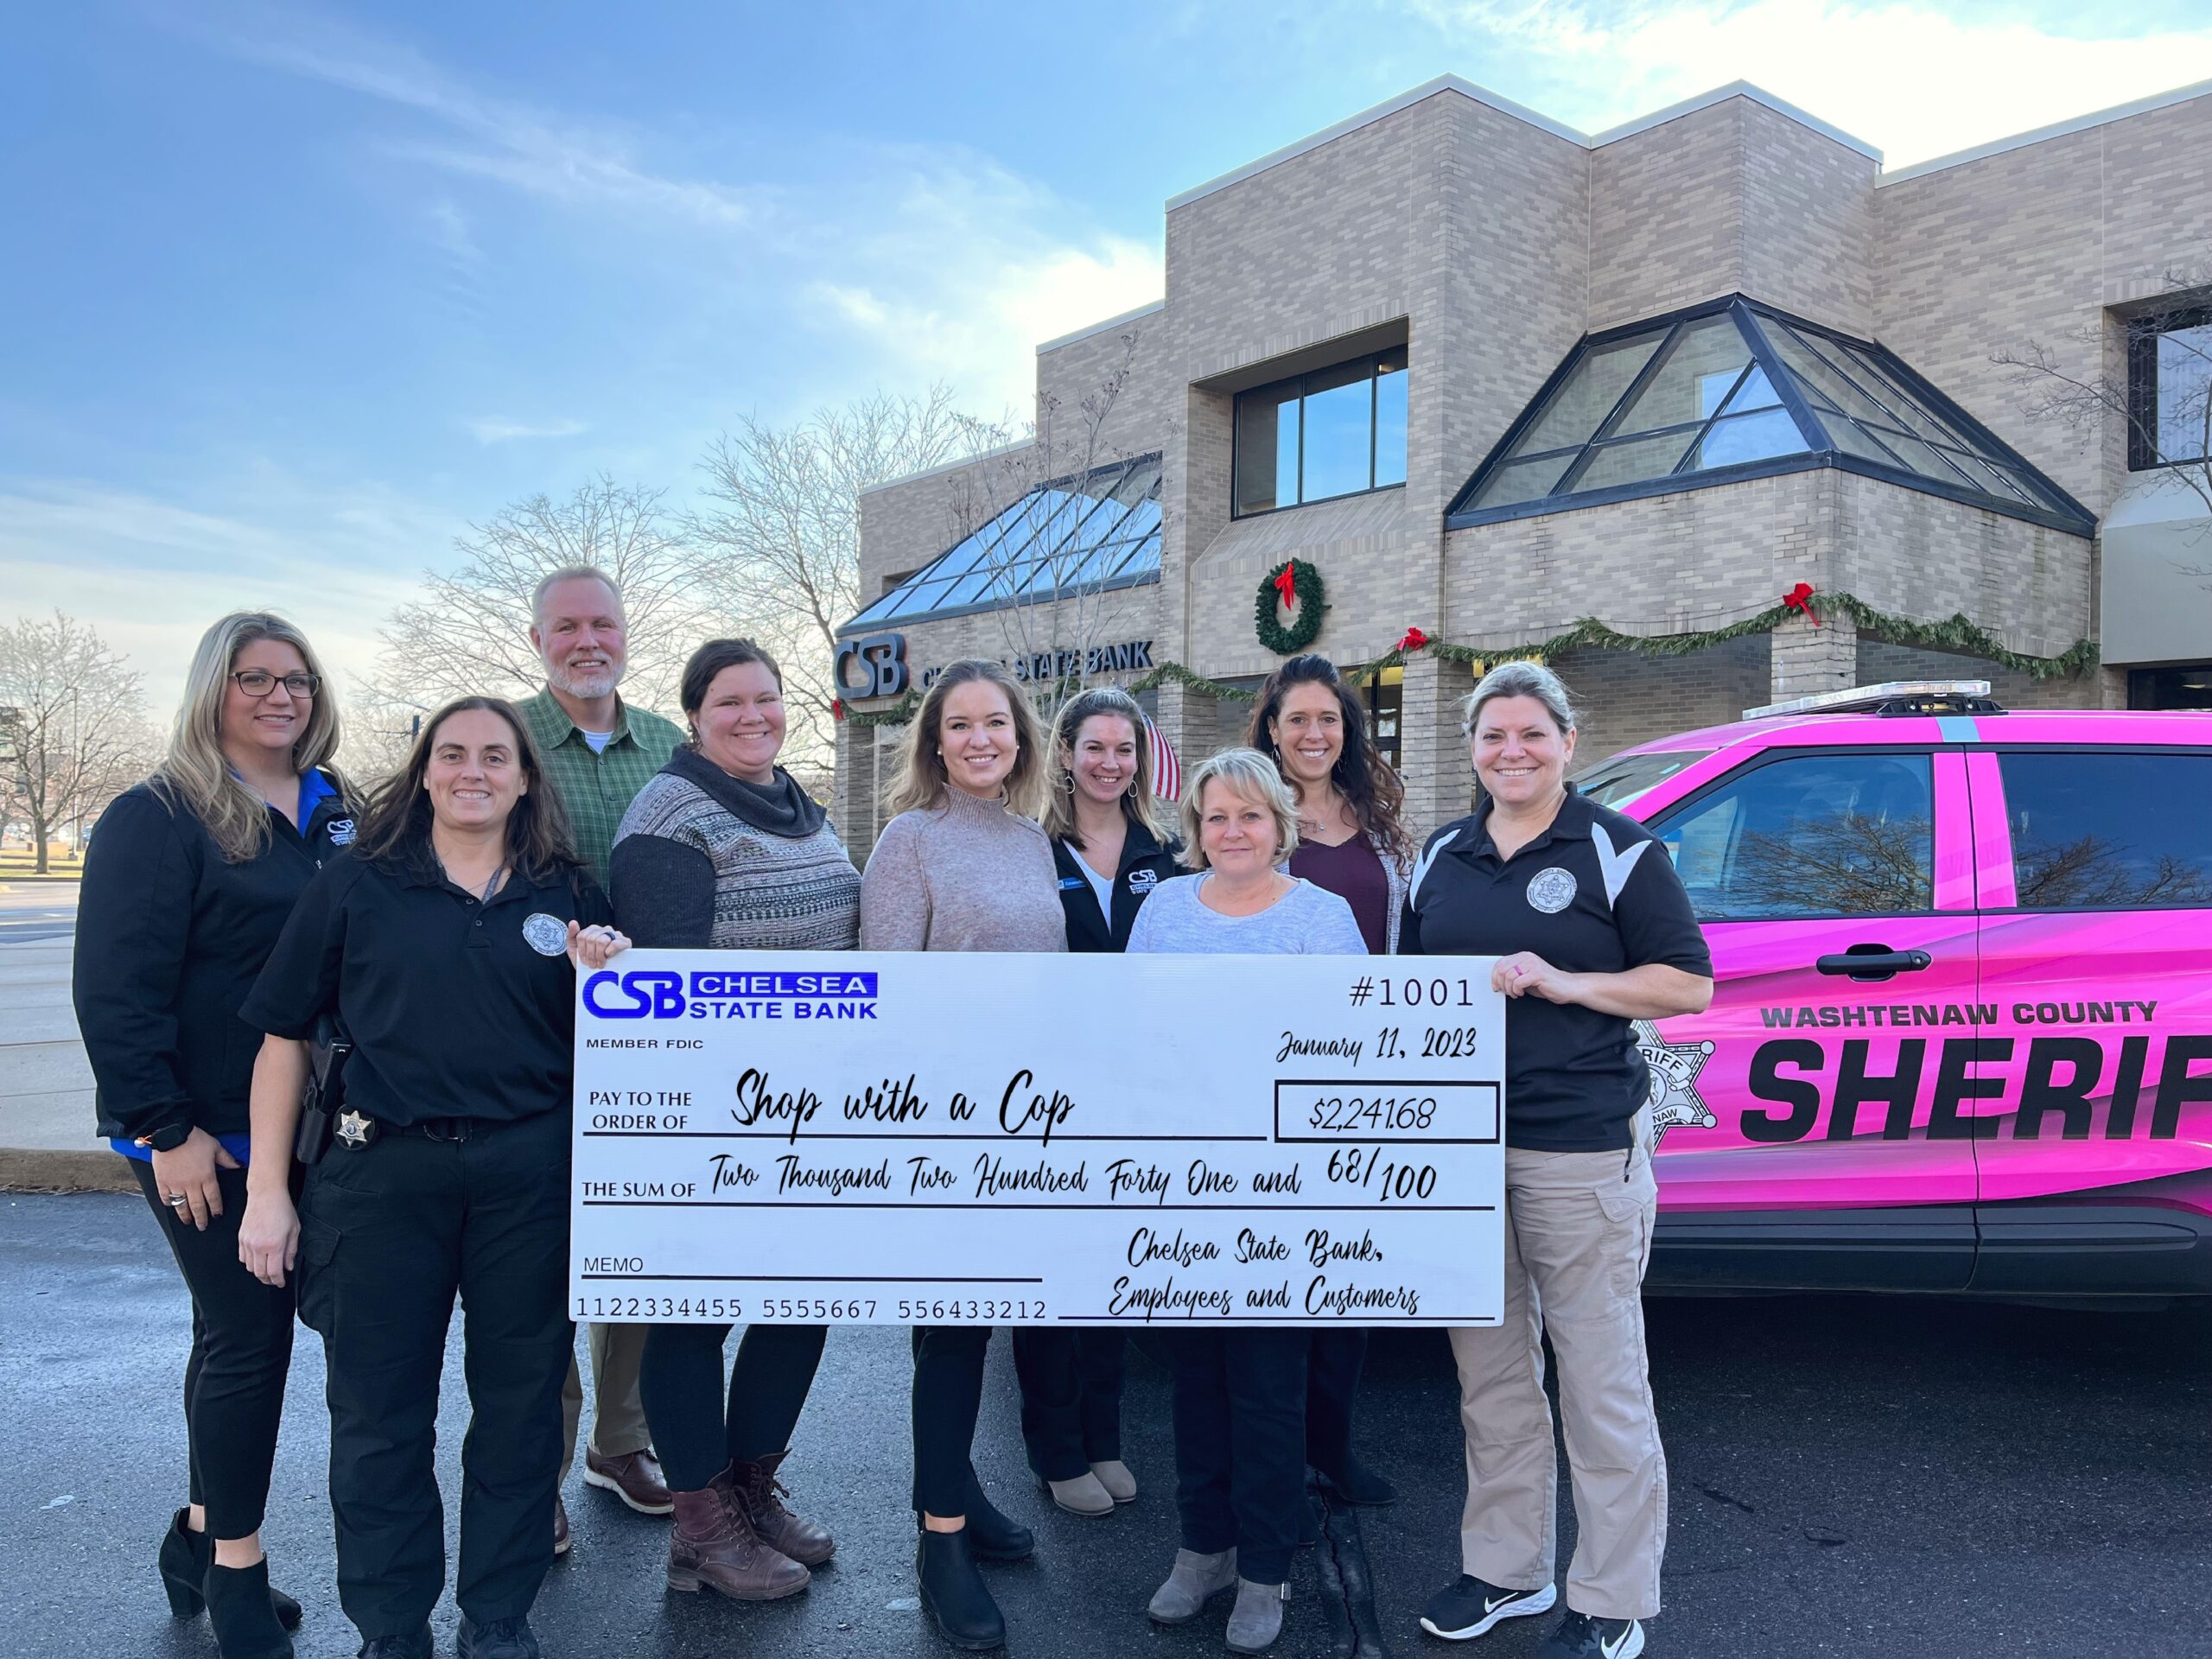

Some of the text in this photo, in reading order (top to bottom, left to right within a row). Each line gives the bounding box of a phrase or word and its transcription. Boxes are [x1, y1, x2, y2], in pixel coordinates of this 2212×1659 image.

[835, 633, 906, 699] CSB
[1014, 650, 1080, 681] STATE
[1086, 641, 1153, 674] BANK
[1128, 869, 1158, 884] CSB
[582, 970, 686, 1019] CSB
[696, 976, 868, 995] CHELSEA
[1349, 976, 1473, 1007] #1001
[689, 1001, 878, 1020] STATE BANK
[1760, 1001, 2158, 1028] WASHTENAW COUNTY
[586, 1039, 704, 1050] MEMBER FDIC
[1275, 1027, 1477, 1068] January 11, 2023
[1642, 1048, 1684, 1071] RIFF
[589, 1091, 692, 1107] PAY TO THE
[1739, 1035, 2212, 1143] SHERIF
[592, 1114, 689, 1130] ORDER OF
[731, 1068, 1076, 1147] Shop with a Cop
[1308, 1097, 1438, 1133] $2,241.68
[582, 1181, 697, 1198] THE SUM OF
[709, 1154, 760, 1195] Two
[775, 1154, 892, 1198] Thousand
[906, 1156, 958, 1197] Two
[973, 1153, 1090, 1199] Hundred
[1104, 1158, 1173, 1205] Forty
[1187, 1159, 1240, 1197] One
[1252, 1162, 1303, 1195] and
[1127, 1227, 1221, 1268] Chelsea
[1234, 1227, 1291, 1264] State
[583, 1256, 644, 1273] MEMO
[575, 1298, 1046, 1319] 1122334455 5555667 556433212
[1109, 1274, 1421, 1324] Employees and Customers
